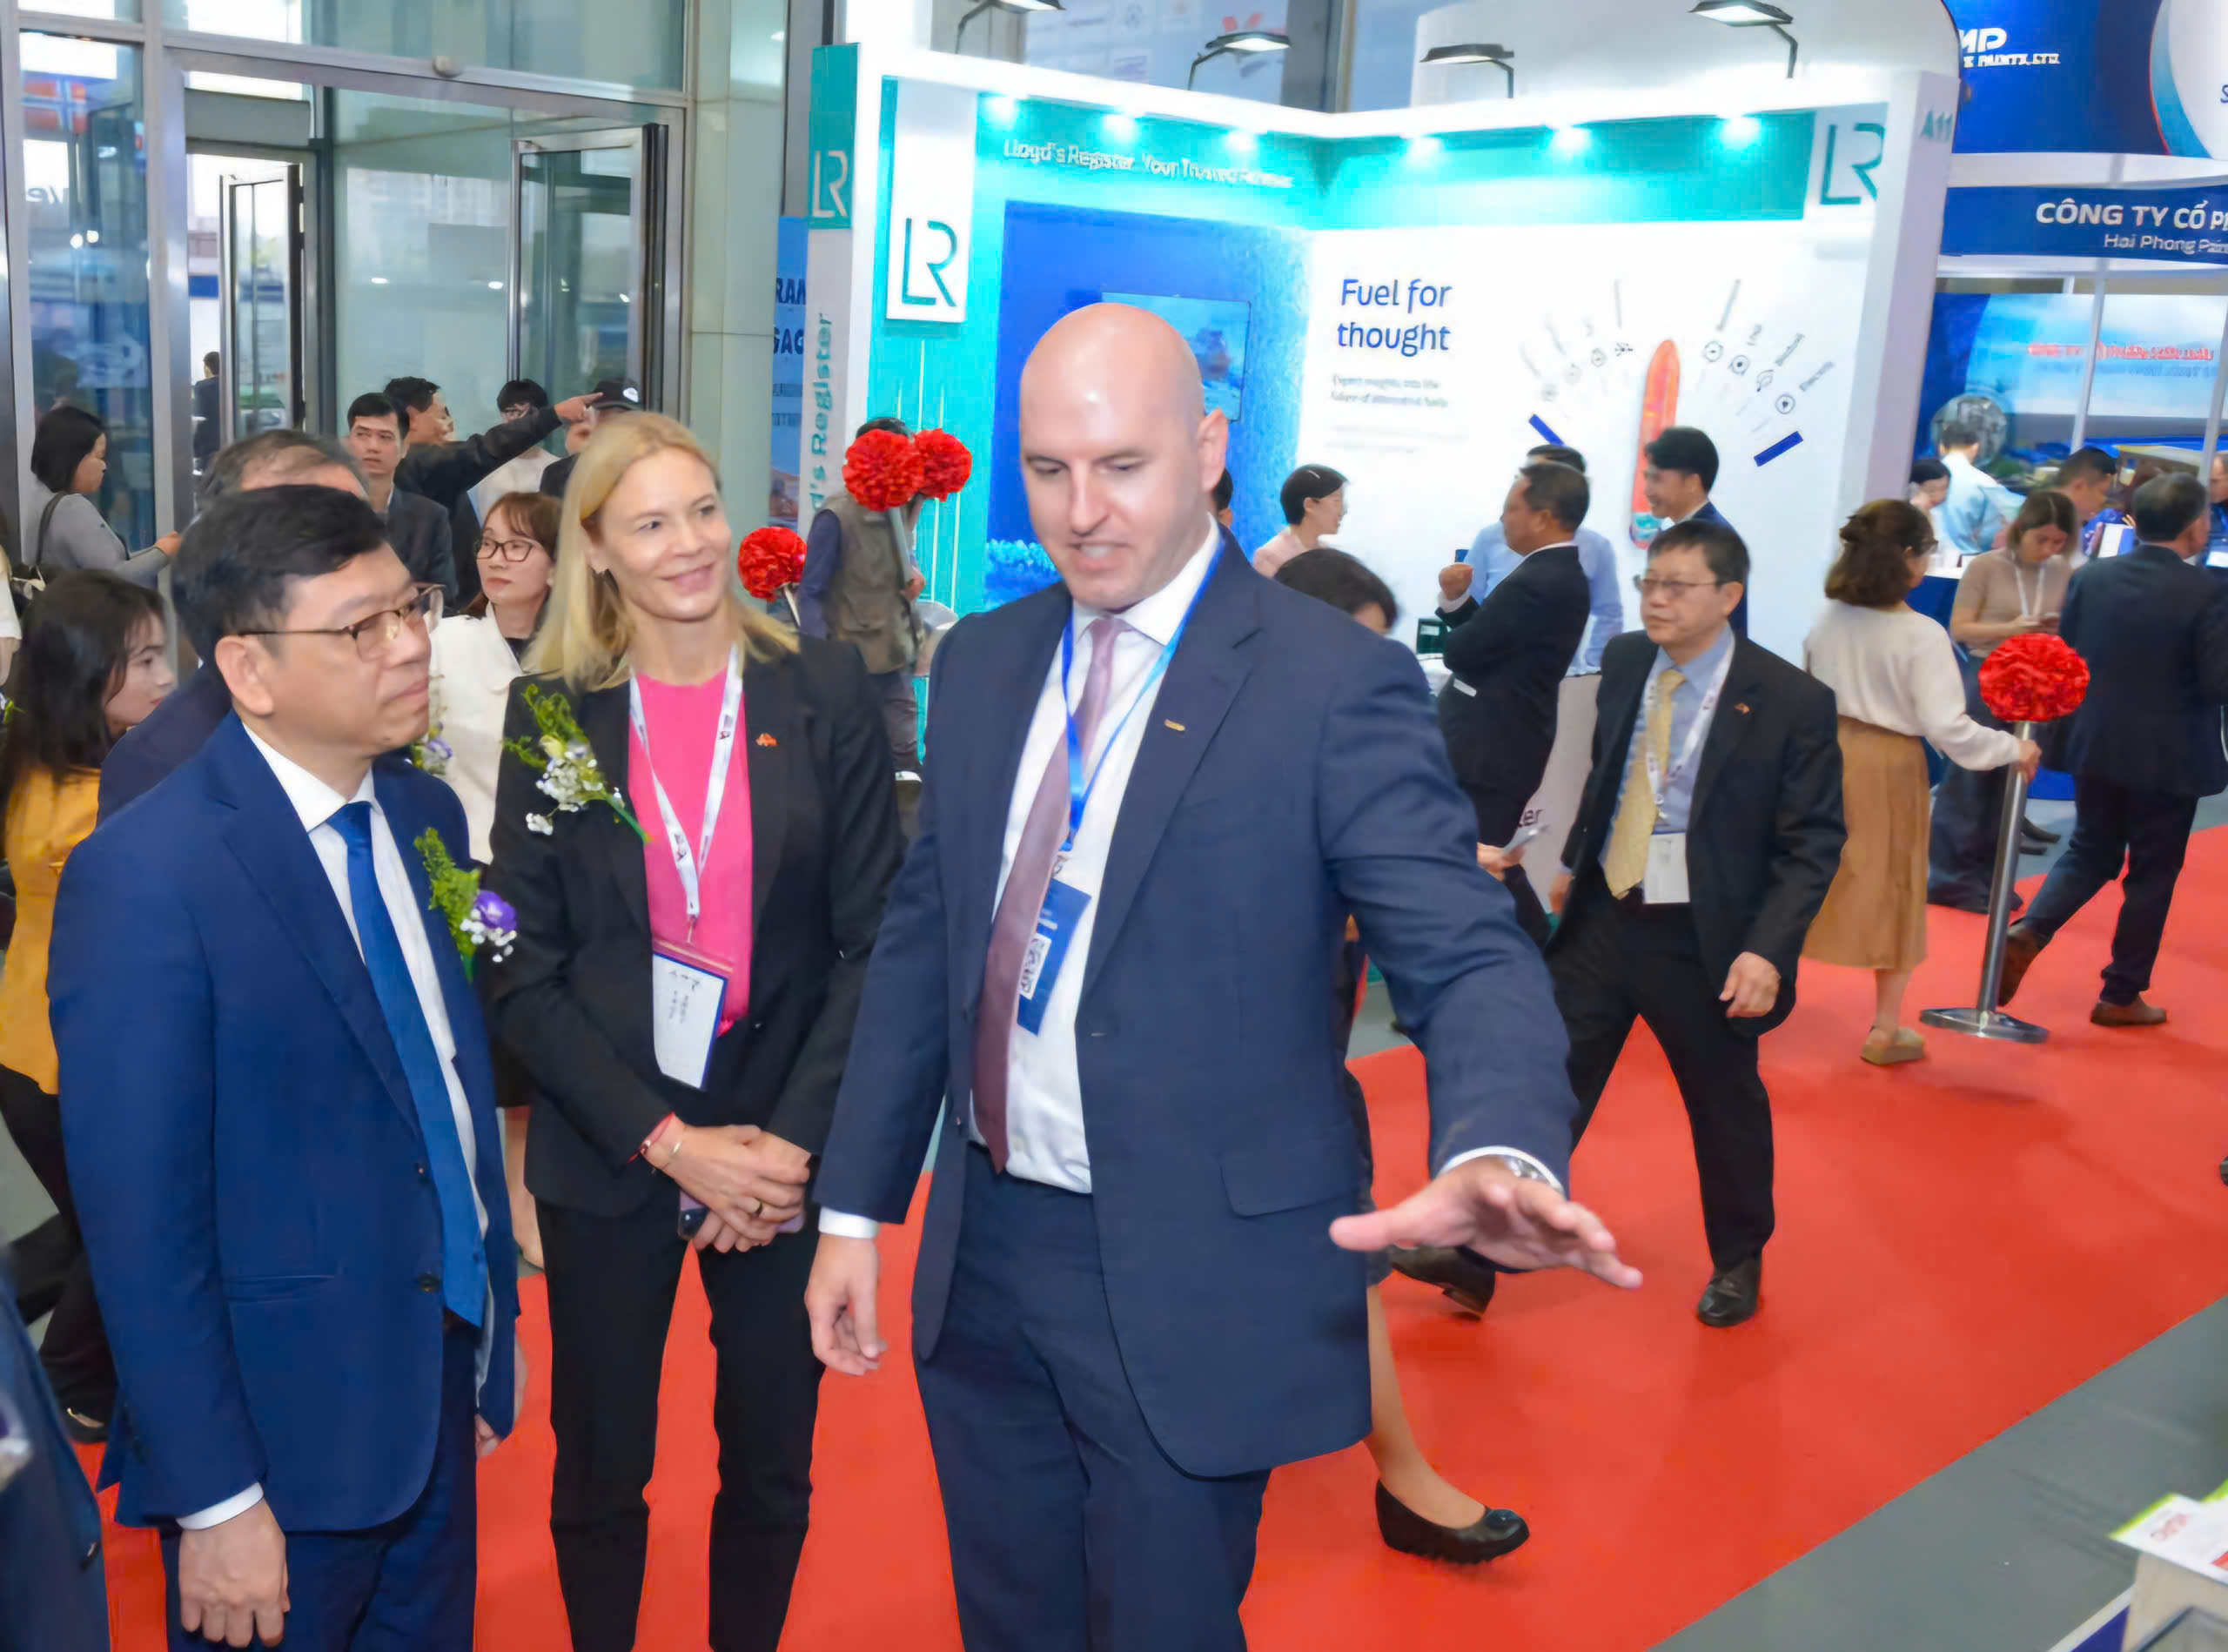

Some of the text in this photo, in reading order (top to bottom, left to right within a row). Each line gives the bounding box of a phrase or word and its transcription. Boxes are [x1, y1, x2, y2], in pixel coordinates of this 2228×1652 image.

[811, 150, 850, 218] LR
[1820, 123, 1886, 205] LR
[2036, 198, 2124, 225] CÔNG
[2131, 205, 2170, 227] TY
[902, 218, 957, 307] LR
[2139, 235, 2196, 255] Phong
[1341, 279, 1453, 313] Fuel for
[1337, 321, 1452, 357] thought
[810, 312, 832, 456] Register
